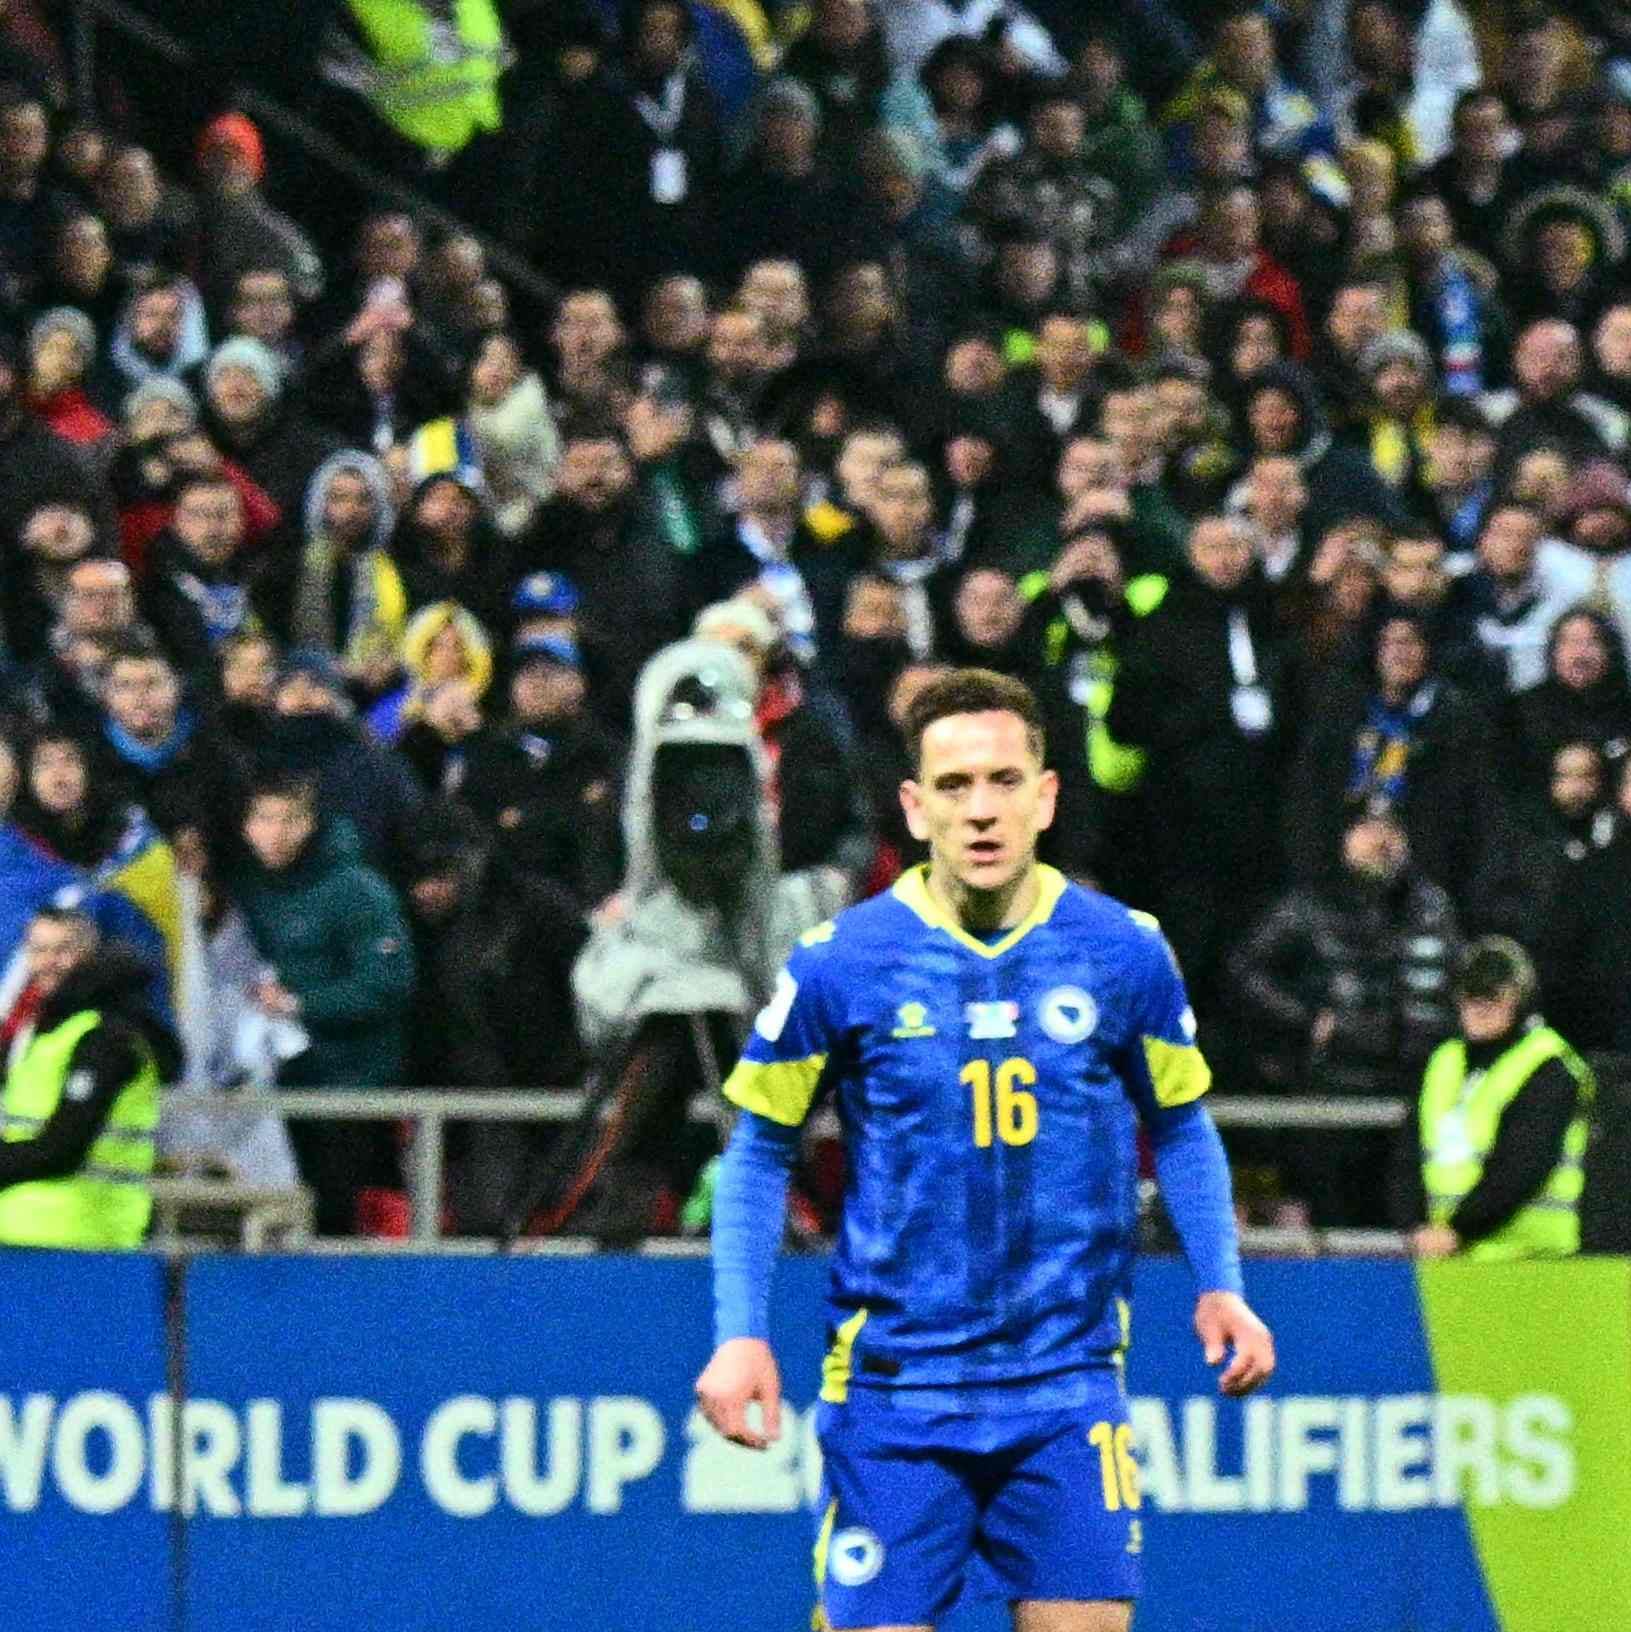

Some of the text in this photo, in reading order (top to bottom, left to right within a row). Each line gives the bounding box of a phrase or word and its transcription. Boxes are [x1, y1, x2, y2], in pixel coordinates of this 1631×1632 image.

[958, 1056, 1040, 1149] 16
[421, 1395, 666, 1518] CUP
[1131, 1394, 1578, 1513] ALIFIERS
